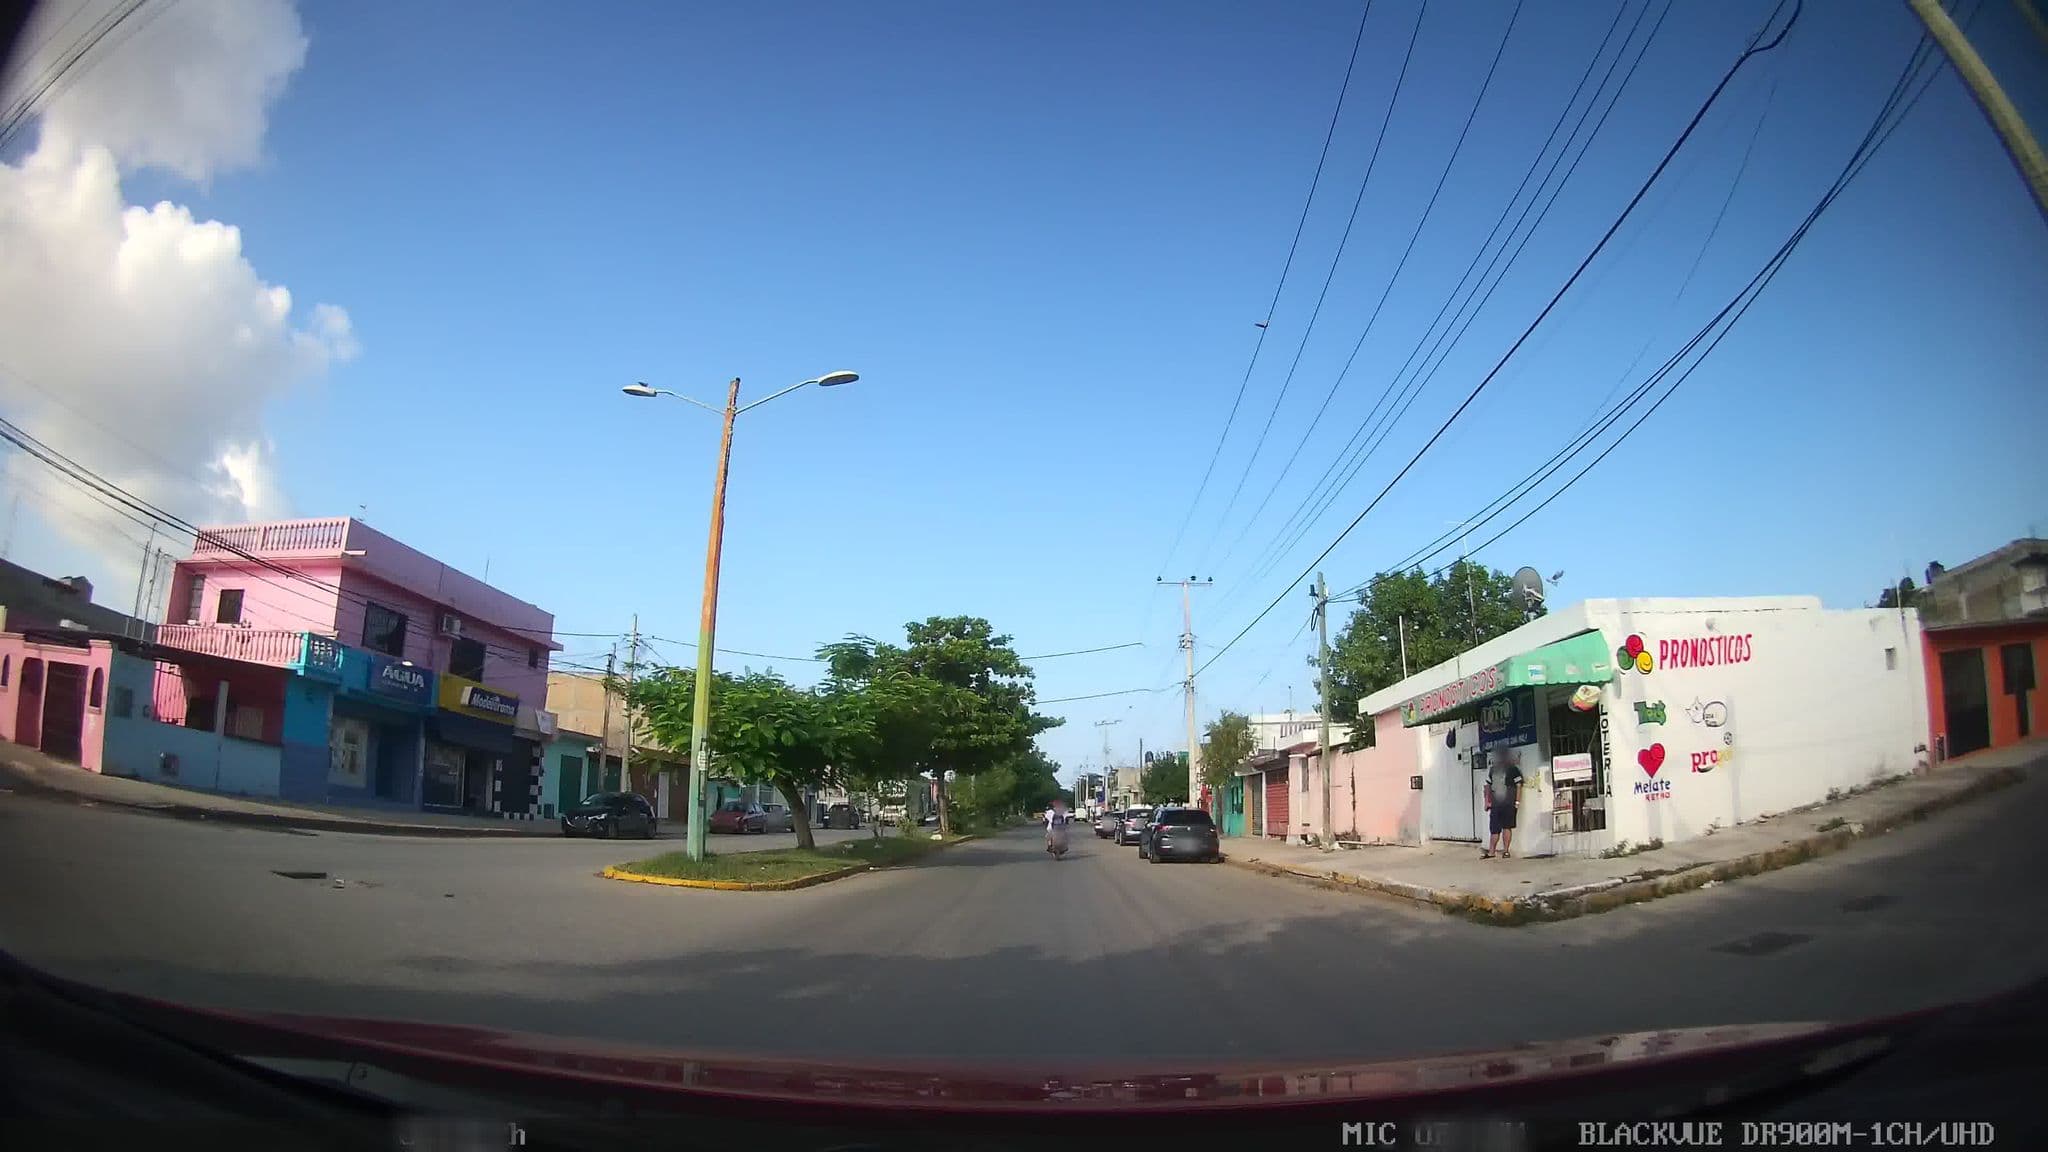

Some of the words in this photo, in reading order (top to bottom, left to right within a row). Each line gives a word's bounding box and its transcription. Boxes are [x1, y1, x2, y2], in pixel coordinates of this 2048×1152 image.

[1658, 634, 1752, 671] PRONOSTICOS
[1419, 667, 1496, 713] PRONOSTICOS
[1599, 704, 1613, 798] LOTERIA
[1633, 779, 1671, 795] Melate
